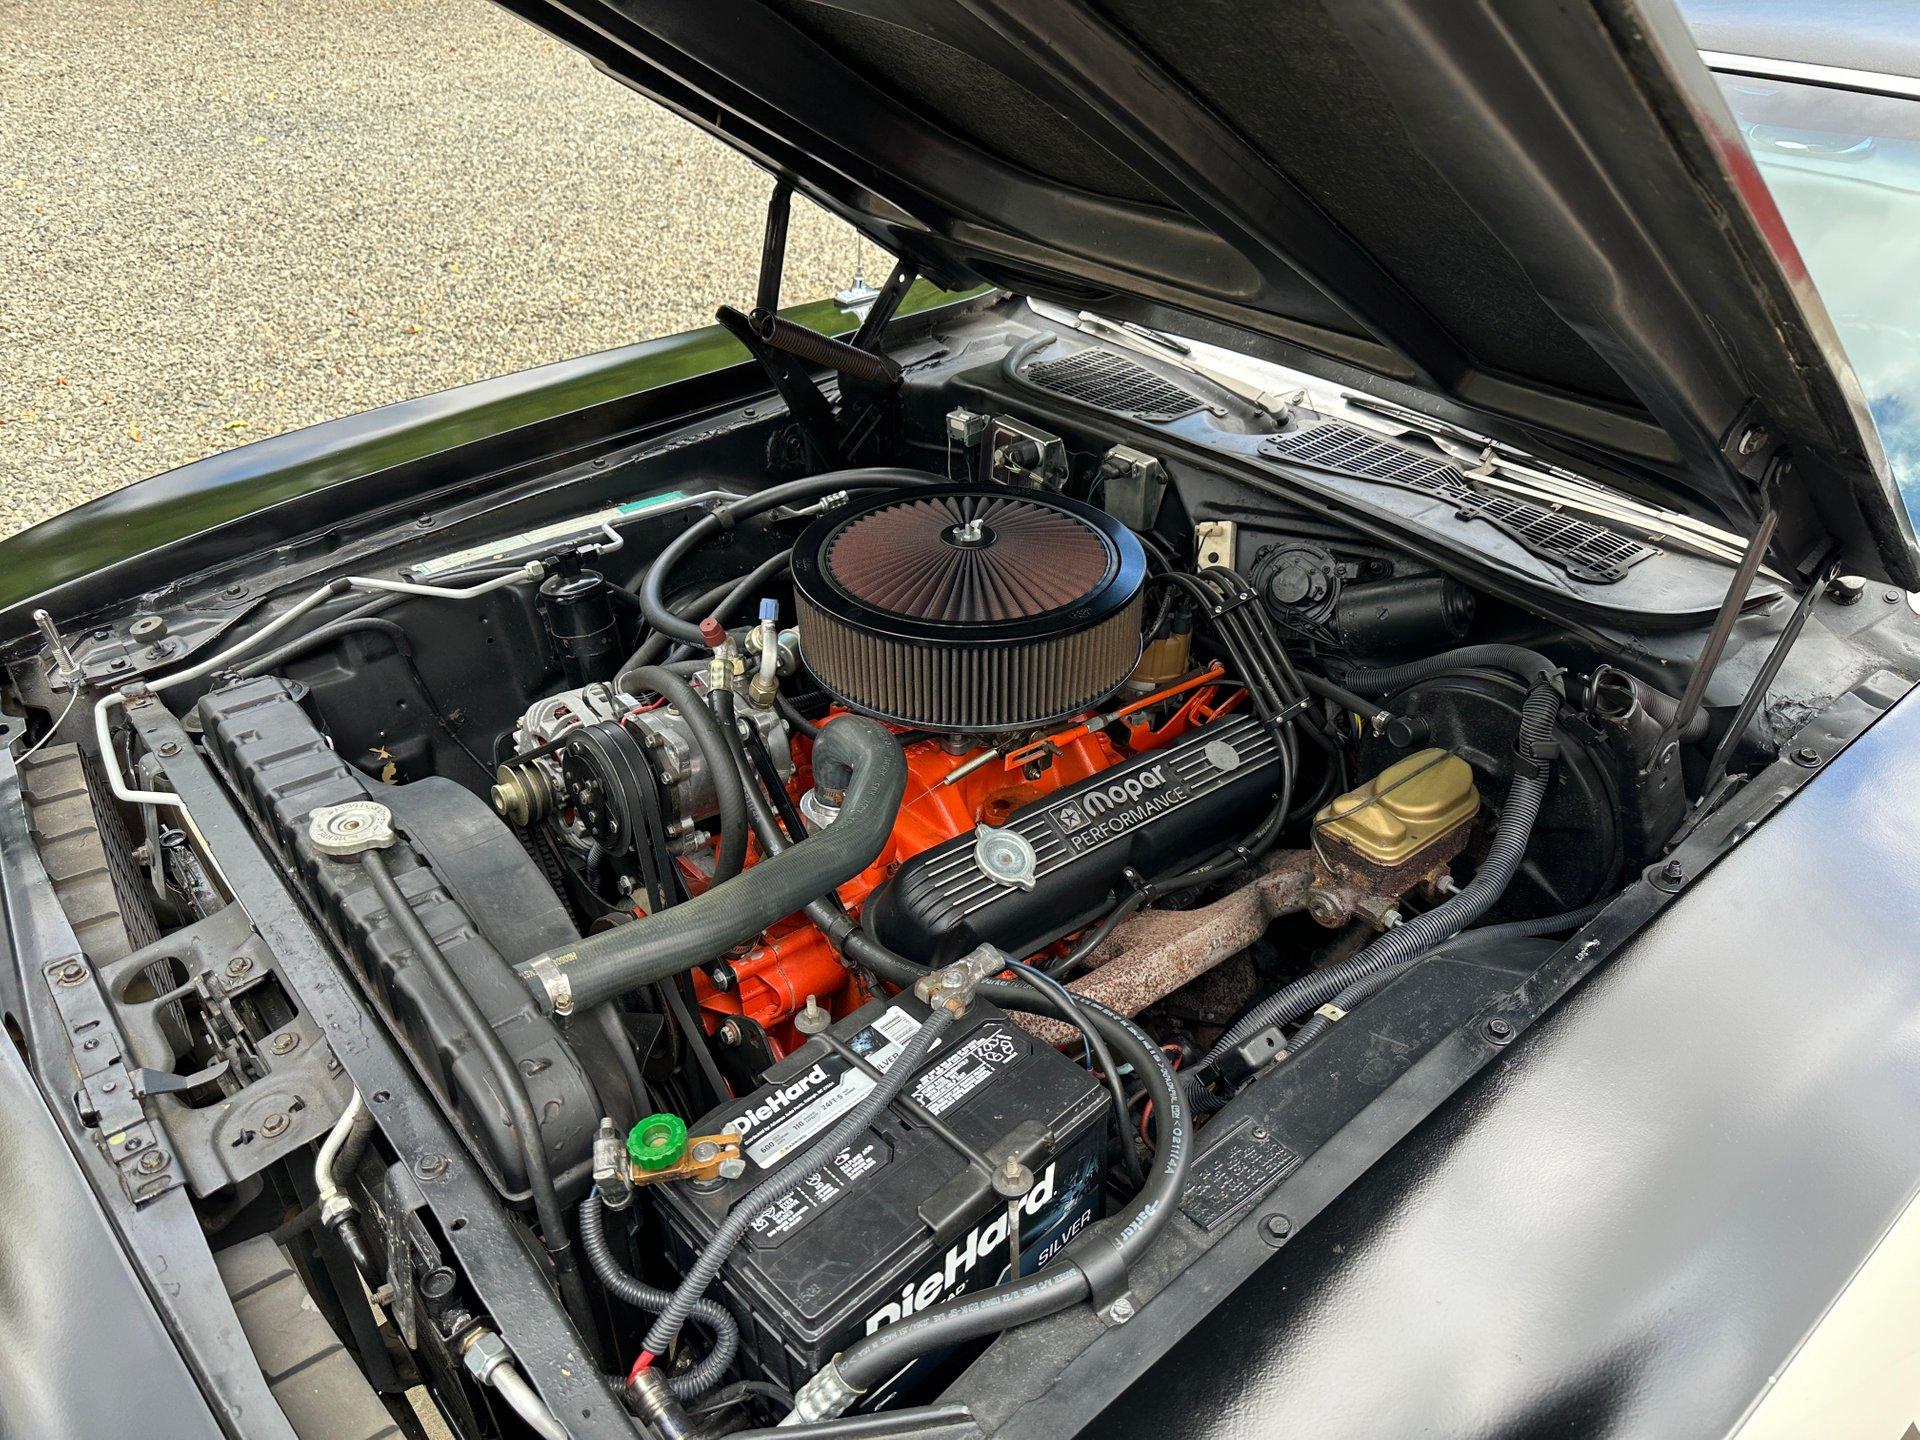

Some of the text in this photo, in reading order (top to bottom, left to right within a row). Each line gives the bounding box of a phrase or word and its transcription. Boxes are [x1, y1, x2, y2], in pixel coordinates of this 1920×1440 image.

[1083, 764, 1167, 818] Mopar
[1071, 786, 1188, 851] PERFORMANCE
[876, 1052, 900, 1071] ILVER
[793, 1121, 804, 1130] 110
[760, 1142, 774, 1153] 600
[1038, 1208, 1092, 1267] SILVER
